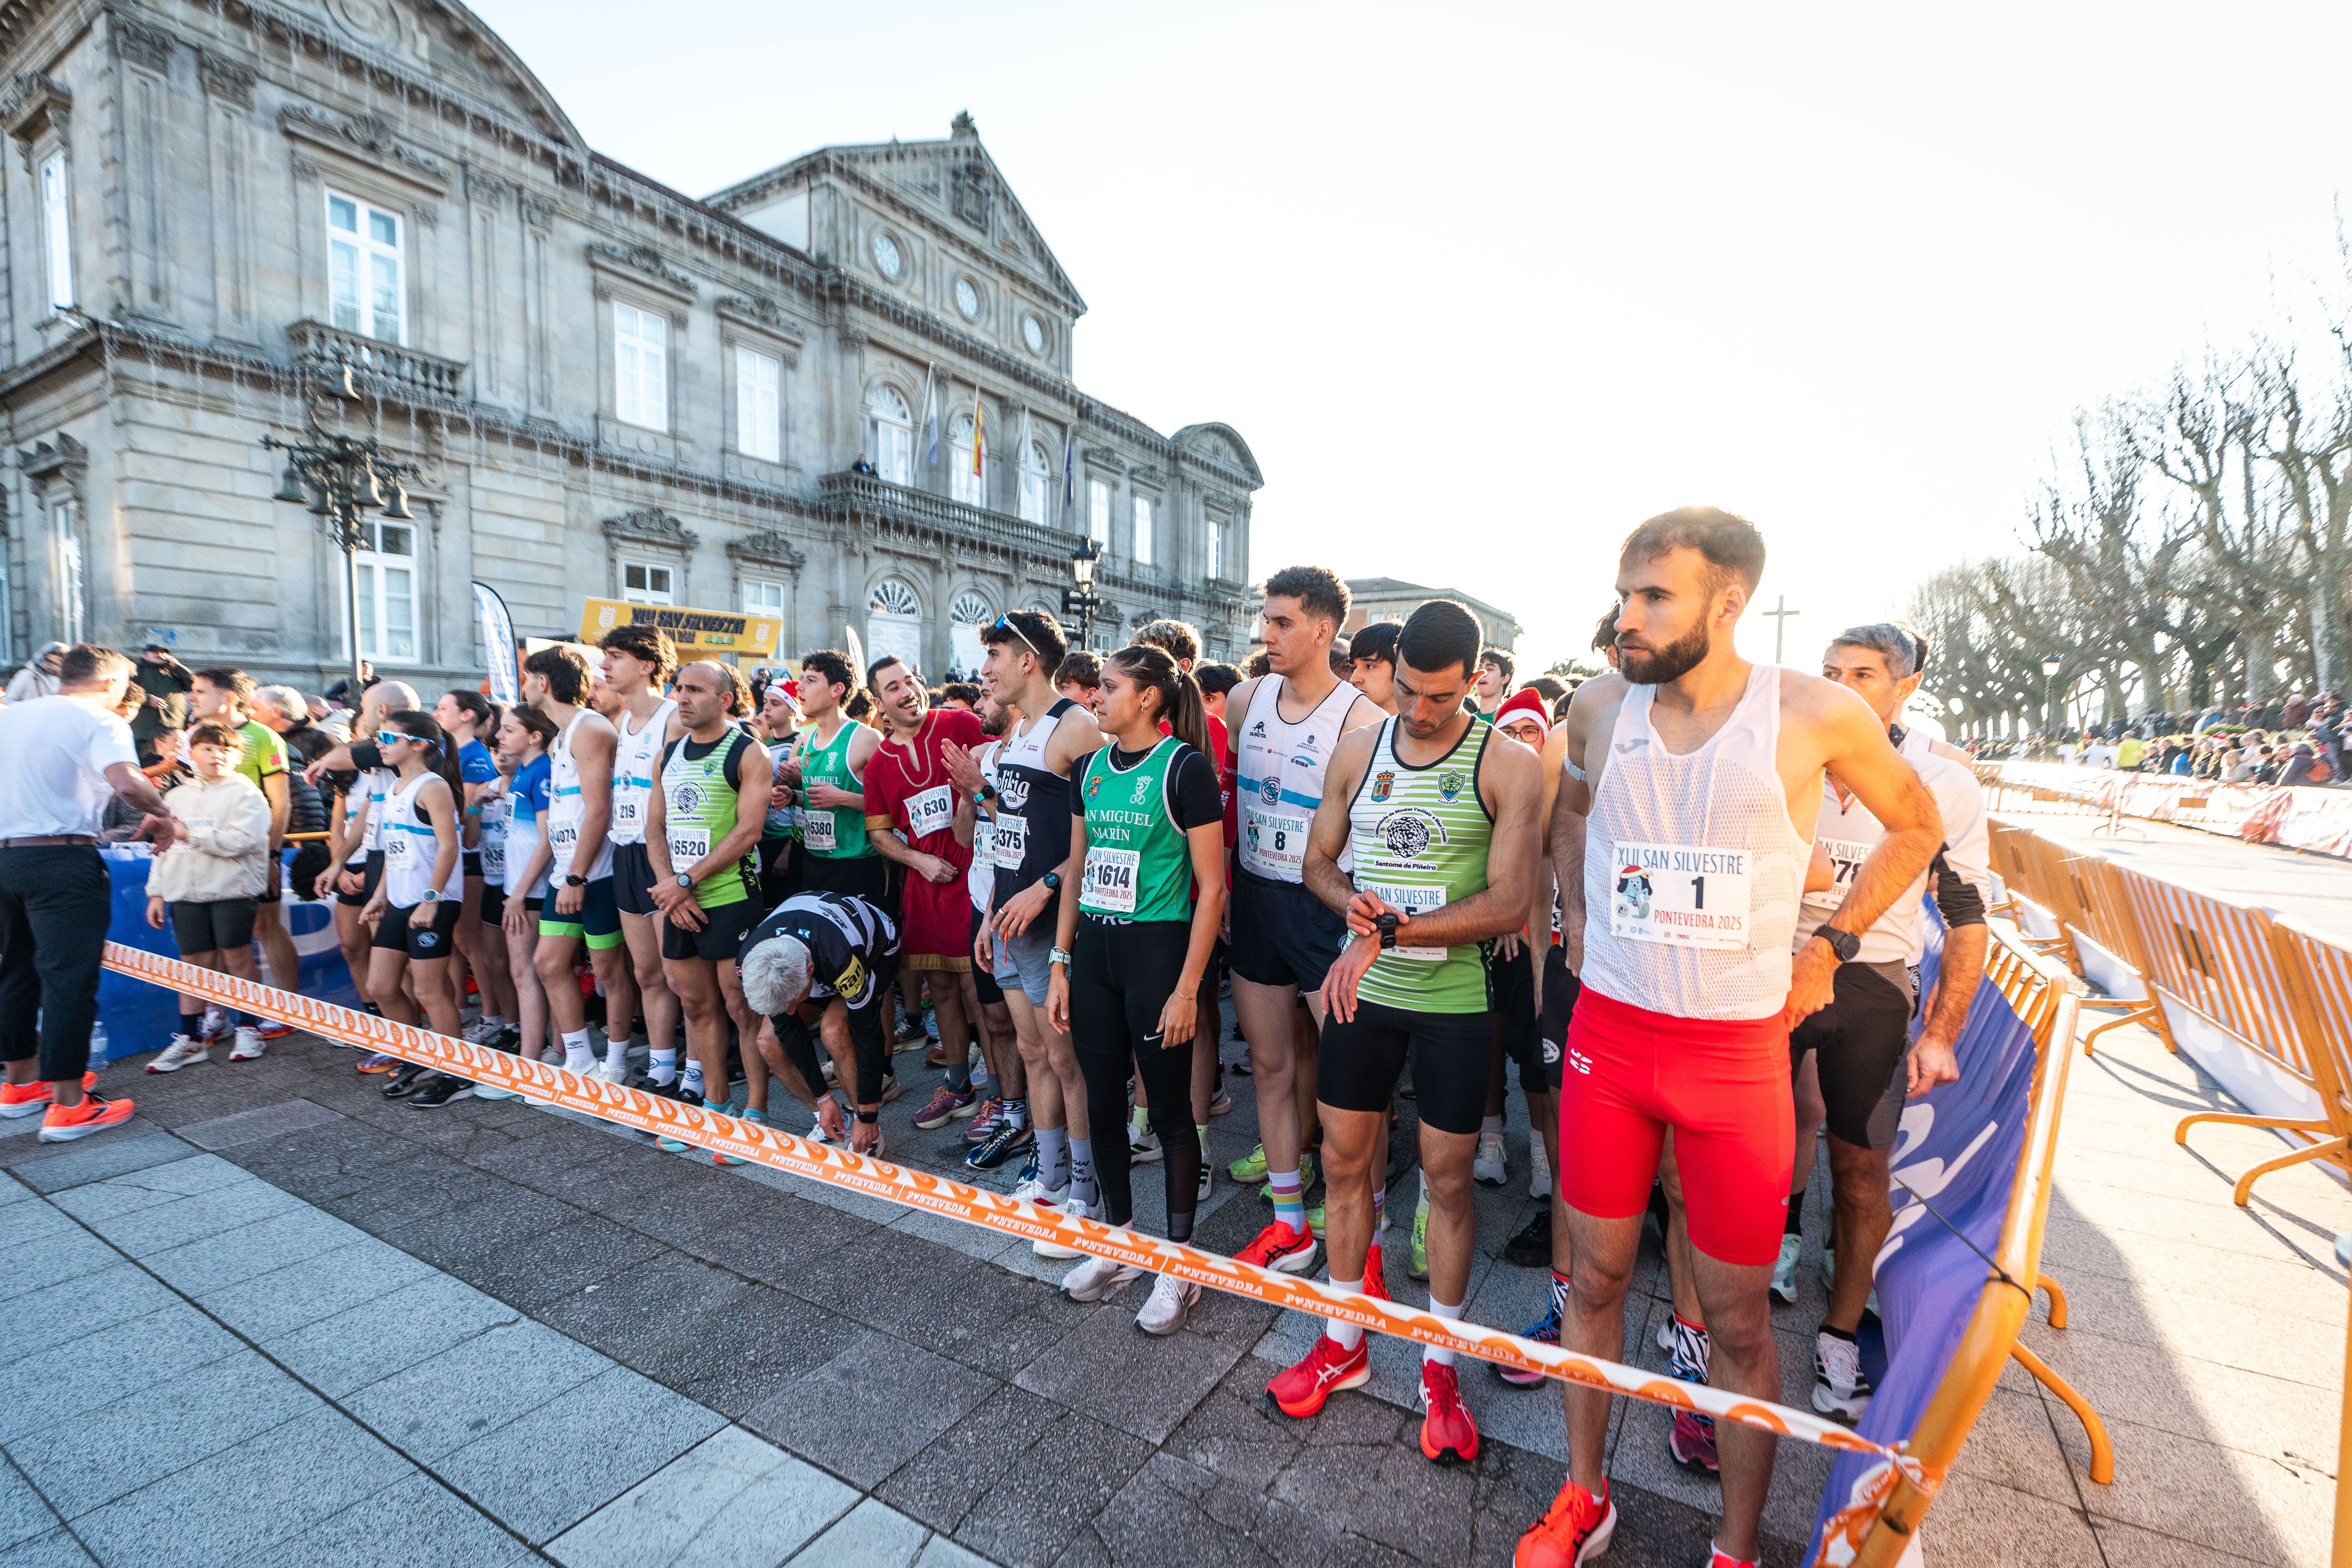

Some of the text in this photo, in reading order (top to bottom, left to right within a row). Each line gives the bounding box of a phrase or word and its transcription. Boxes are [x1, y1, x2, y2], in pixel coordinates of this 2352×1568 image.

[960, 546, 1007, 564] PROVINCIAL
[1296, 744, 1319, 753] PONTEVEDRA
[809, 776, 841, 784] MIGUEL
[997, 769, 1031, 798] elikia
[923, 787, 949, 801] SILVESTRE
[1006, 793, 1018, 803] fresh
[619, 804, 635, 818] 219
[924, 797, 947, 816] 630
[813, 813, 832, 821] SILVESTRE
[923, 814, 943, 825] PONTEVEDRA
[998, 816, 1023, 831] SILVESTRE
[1084, 810, 1154, 827] AN MIGUEL
[1255, 813, 1267, 826] SAN
[1268, 816, 1304, 833] SILVESTRE
[810, 821, 832, 835] 5380
[1091, 825, 1131, 842] MARÍN
[1375, 815, 1389, 838] Comunidade
[1434, 818, 1443, 829] Man
[555, 828, 577, 843] 4074
[679, 830, 707, 840] SILVESTRE
[996, 827, 1022, 849] 6375
[1274, 831, 1286, 851] 8
[674, 840, 706, 856] 6520
[1012, 851, 1022, 859] 2025
[1259, 848, 1302, 864] PONTEVEDRA 2025
[1092, 849, 1102, 862] SAN
[1102, 850, 1136, 866] SILVESTRE
[1618, 847, 1744, 875] XLII SAN SILVESTRE
[1098, 864, 1131, 889] 1614
[1094, 886, 1132, 900] PONTEVEDRA 2025
[1375, 886, 1391, 902] SAN
[1394, 888, 1441, 905] SILVESTRE
[1691, 876, 1704, 909] 1
[1654, 909, 1742, 930] PONTEVEDRA 2025
[1073, 1167, 1085, 1175] OR
